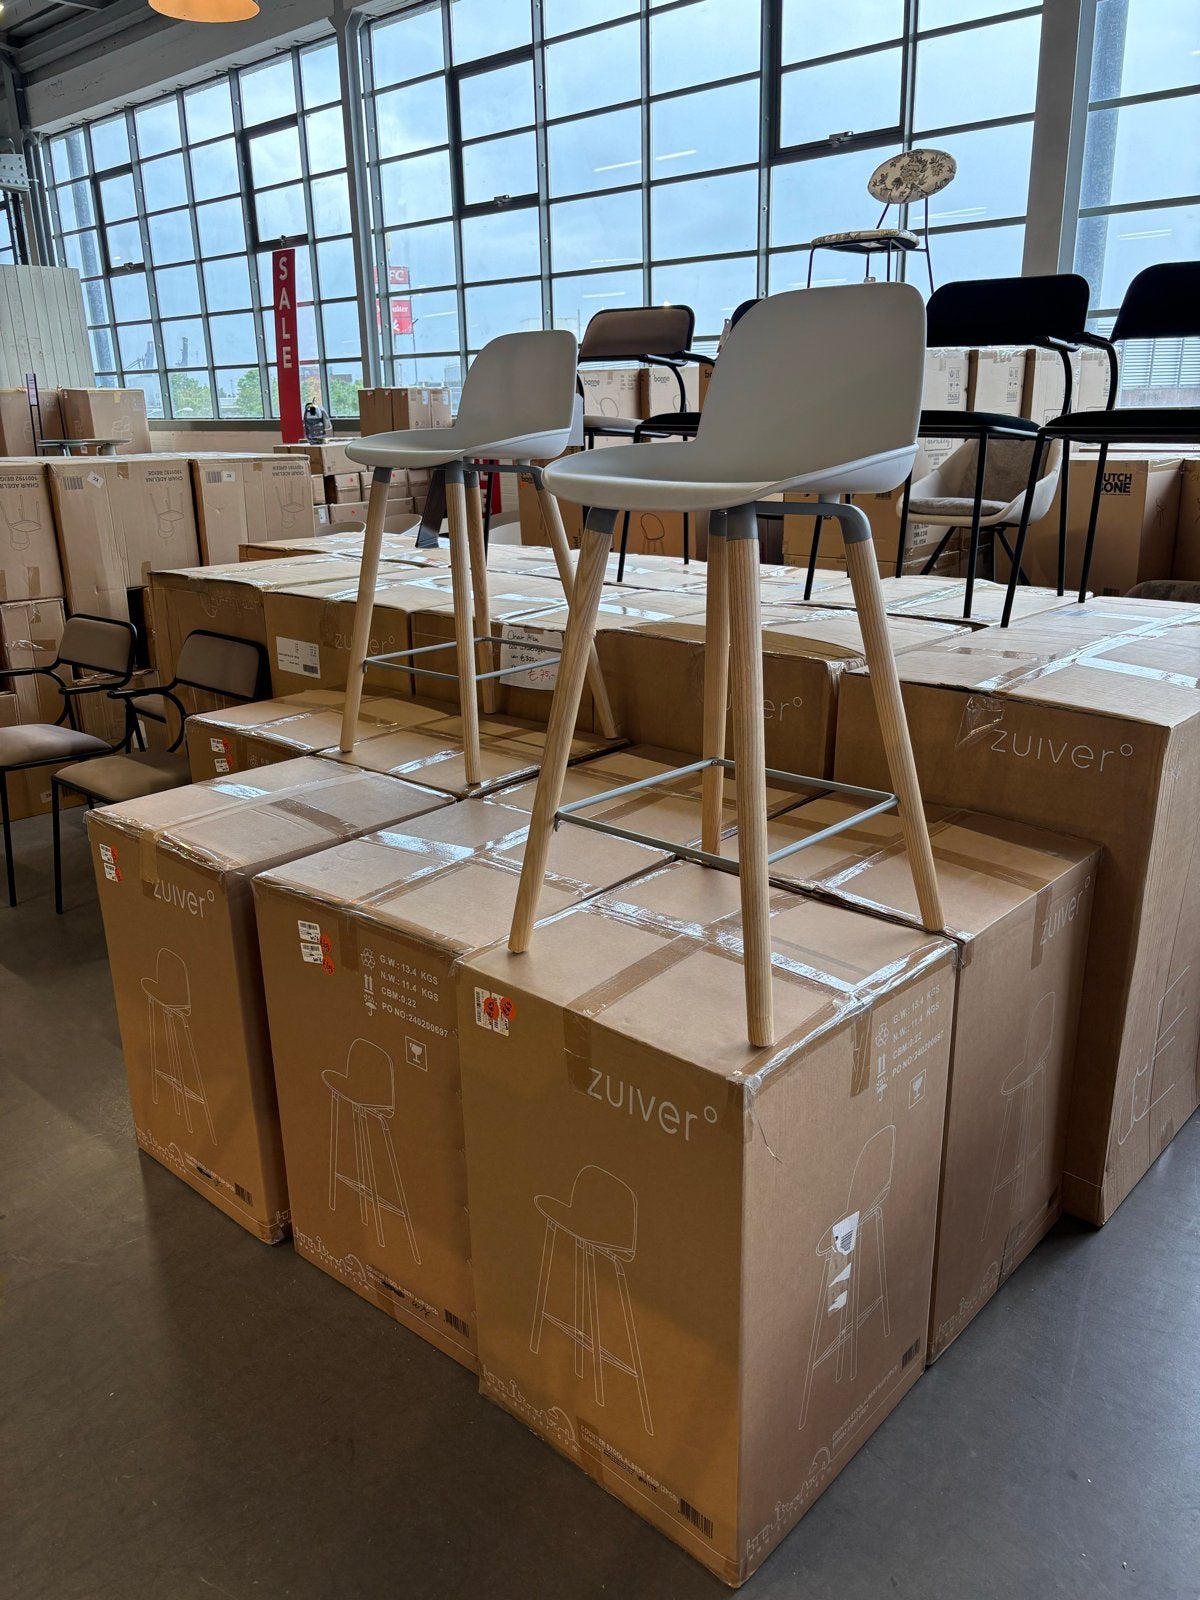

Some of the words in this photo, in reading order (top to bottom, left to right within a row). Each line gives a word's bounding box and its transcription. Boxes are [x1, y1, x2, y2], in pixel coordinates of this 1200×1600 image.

[279, 256, 293, 369] SALE
[1103, 472, 1132, 482] UTCH
[401, 963, 417, 977] 13.4
[420, 970, 439, 985] KGS
[401, 979, 417, 993] 11.4
[421, 988, 439, 1002] KGS
